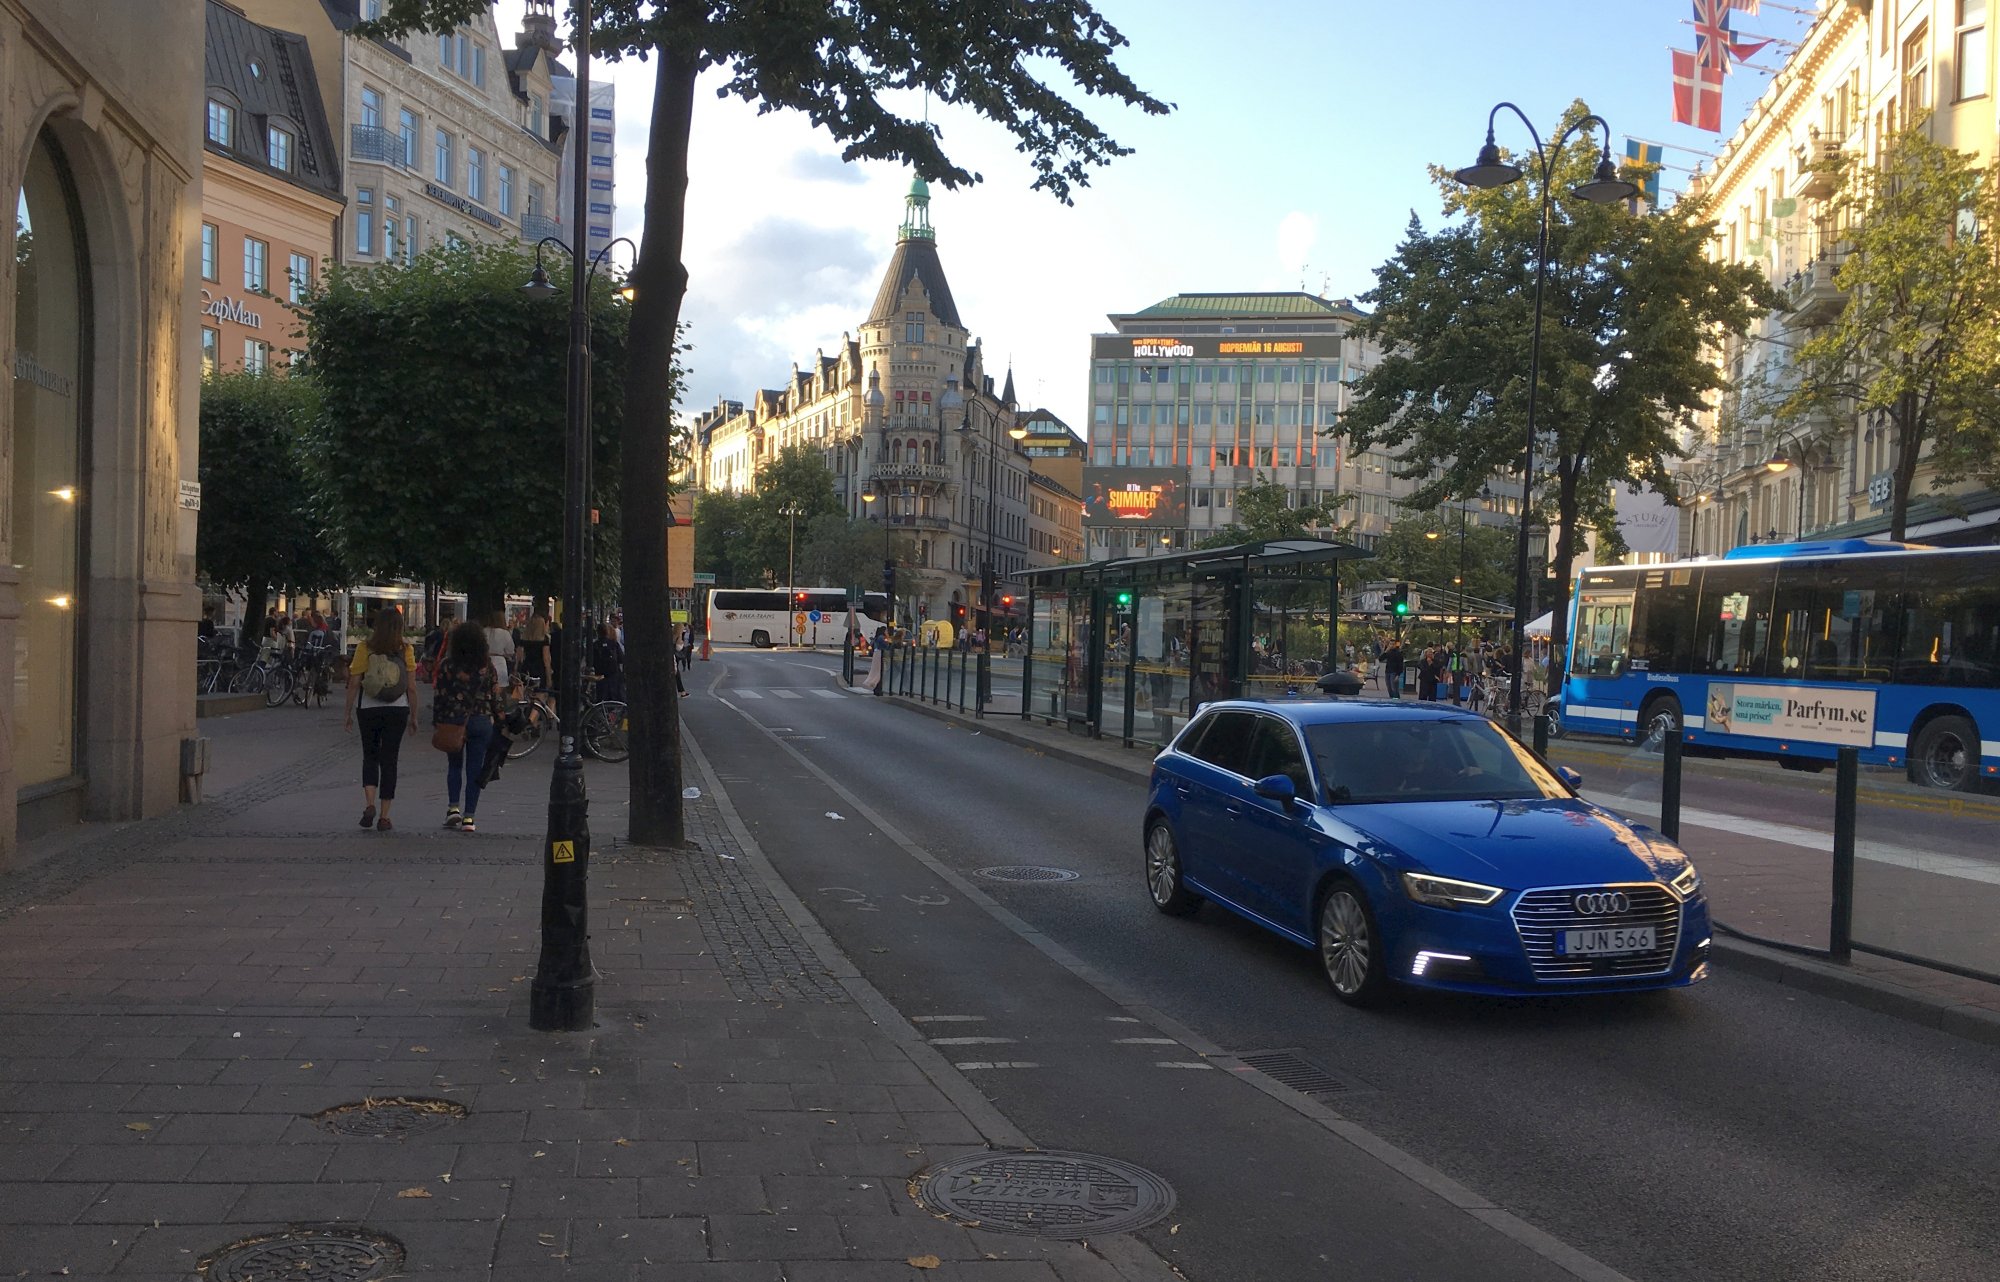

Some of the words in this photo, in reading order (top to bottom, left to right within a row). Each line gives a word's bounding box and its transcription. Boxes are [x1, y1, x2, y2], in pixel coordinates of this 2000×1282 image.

[1134, 345, 1194, 357] HOLLYWOOD
[1220, 341, 1261, 353] BIOPREMIÄR
[1263, 342, 1272, 353] 16
[1273, 342, 1303, 353] AUGUSTI
[1868, 477, 1890, 504] SEB
[1109, 490, 1157, 509] SUMMER
[1736, 700, 1753, 708] Stora
[1754, 700, 1782, 711] märken,
[1735, 711, 1749, 720] små
[1749, 711, 1771, 722] priser!
[1786, 699, 1867, 727] Parfym.se
[1574, 932, 1608, 950] JJN
[1615, 930, 1649, 948] 566
[994, 1179, 1082, 1188] STOCKHOLM
